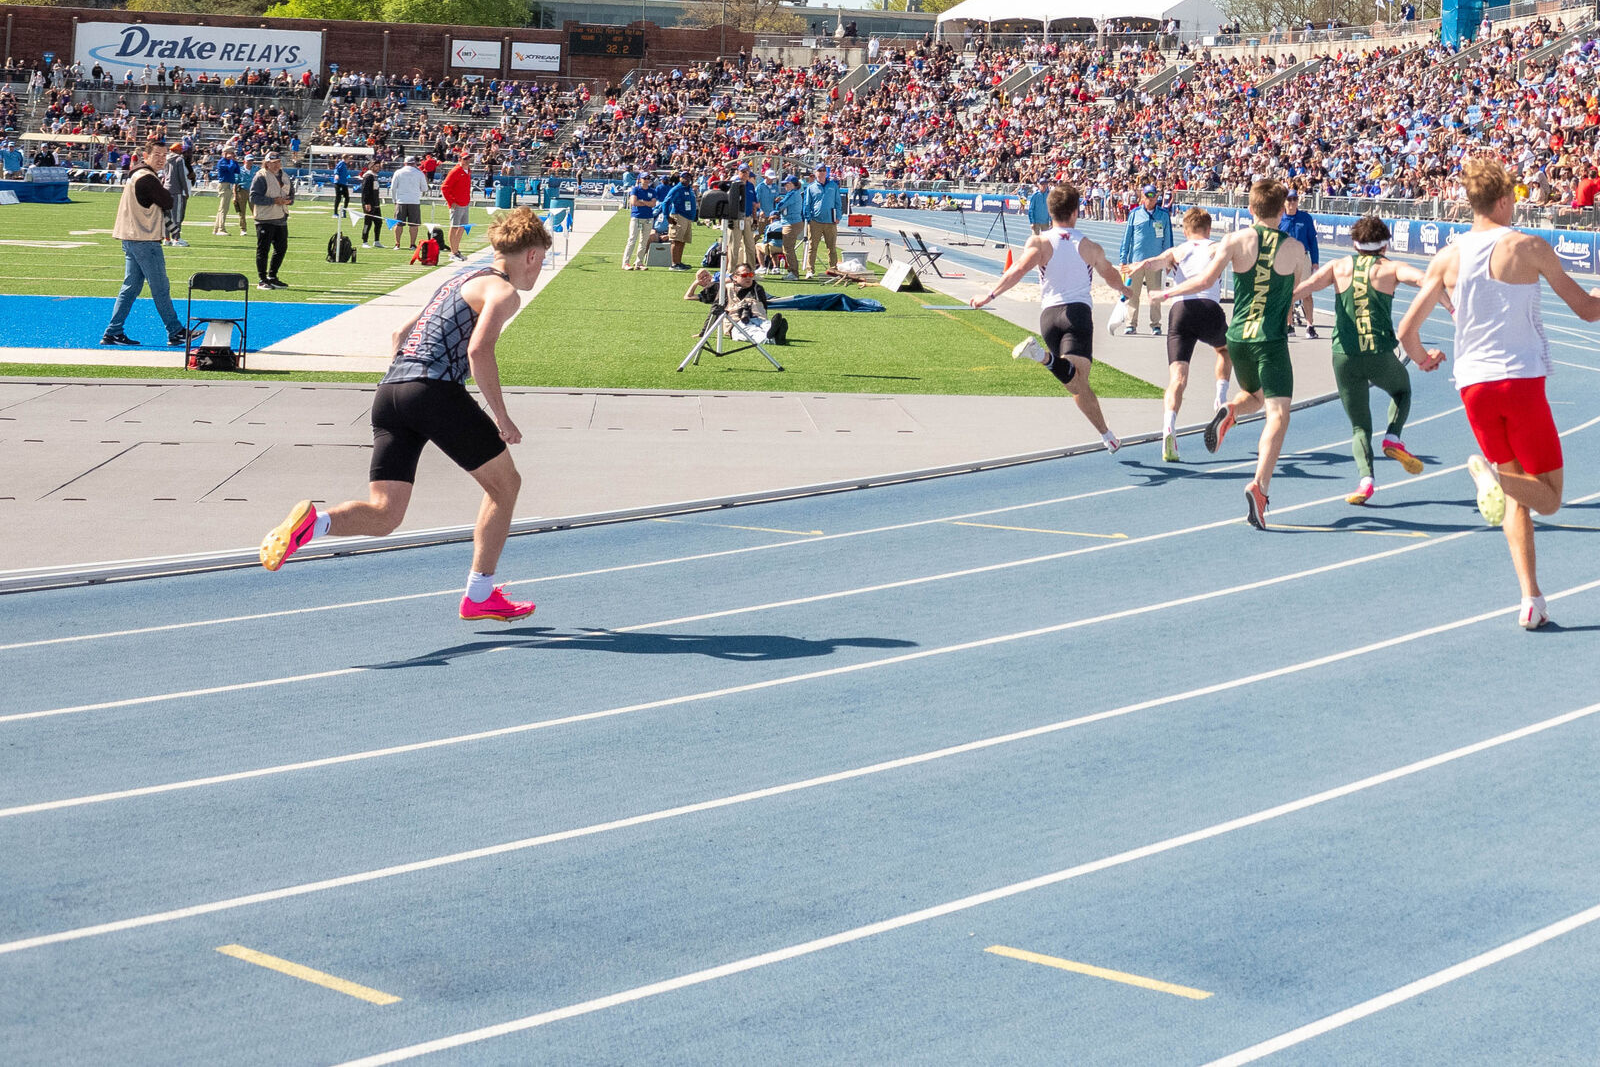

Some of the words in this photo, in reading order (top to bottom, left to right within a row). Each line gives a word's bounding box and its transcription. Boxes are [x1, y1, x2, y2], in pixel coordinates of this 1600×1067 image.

[114, 26, 216, 60] Drake
[219, 43, 301, 64] RELAYS
[1241, 230, 1279, 340] STANGS
[1352, 255, 1375, 352] STANGS
